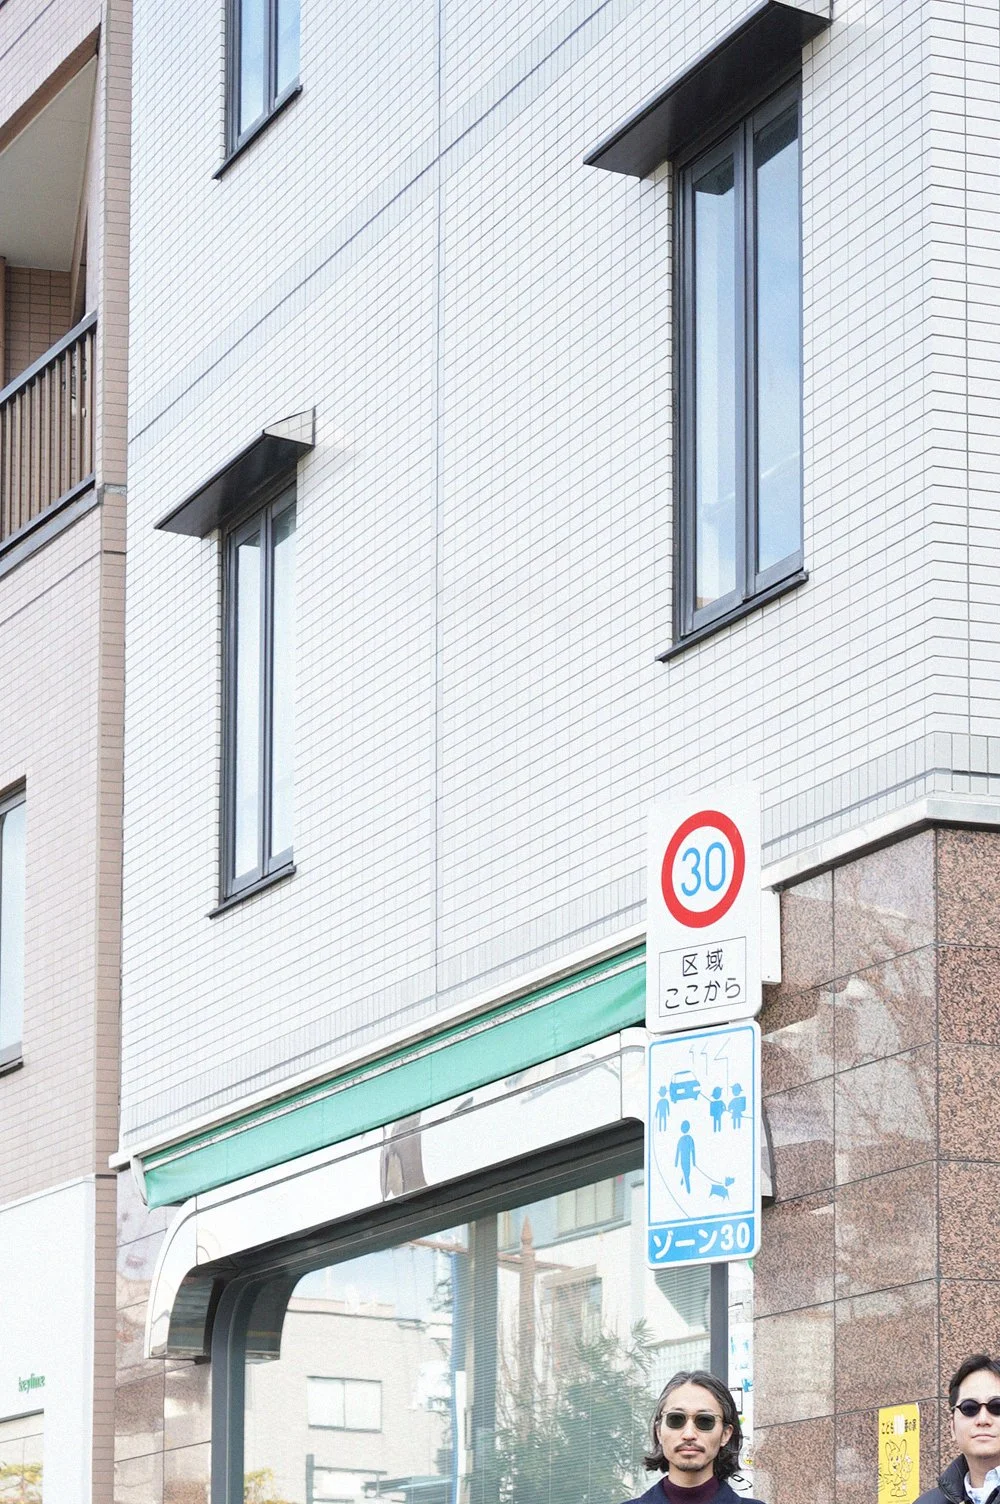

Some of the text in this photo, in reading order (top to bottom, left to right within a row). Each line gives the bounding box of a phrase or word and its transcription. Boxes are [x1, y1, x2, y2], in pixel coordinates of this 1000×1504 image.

[681, 842, 726, 896] 30
[682, 948, 724, 977] 区域
[665, 977, 741, 1009] ここから
[653, 1222, 750, 1259] ゾーン30
